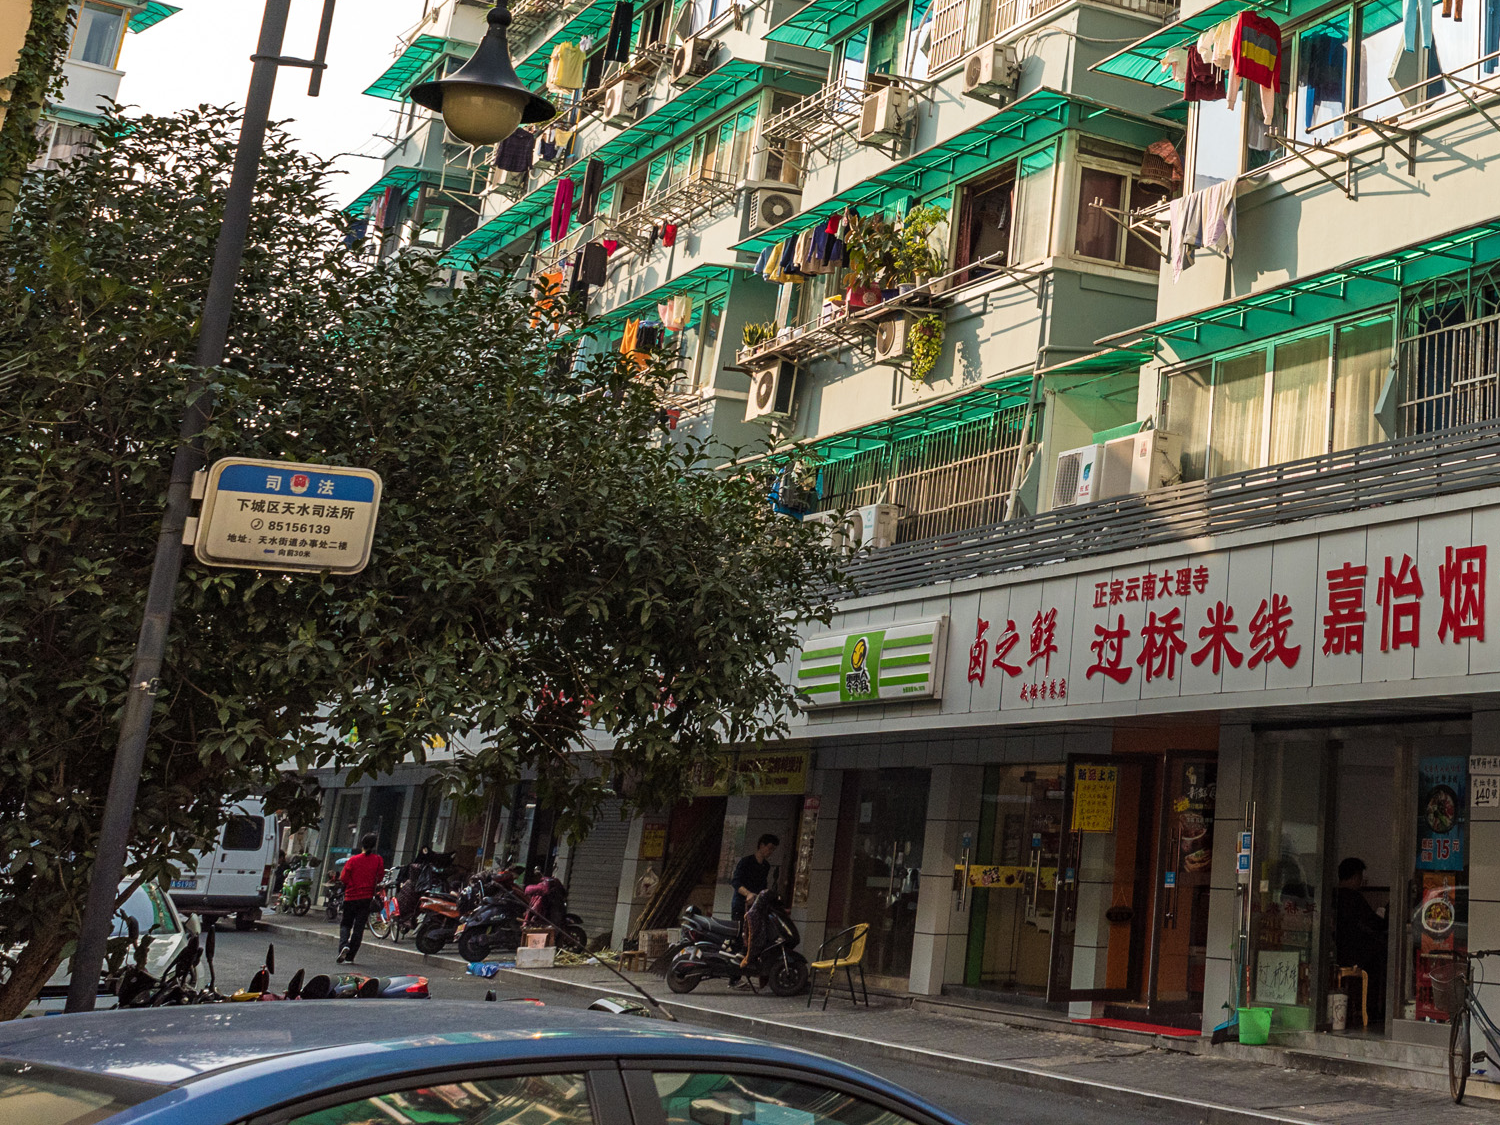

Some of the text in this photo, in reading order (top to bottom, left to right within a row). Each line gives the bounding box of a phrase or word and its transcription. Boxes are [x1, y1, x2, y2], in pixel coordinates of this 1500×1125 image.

[236, 498, 356, 521] 下城区天水司法所
[267, 520, 331, 535] 85156139
[1092, 566, 1209, 609] 正宗云南大理寺
[967, 607, 1059, 687] 卤之鲜
[1086, 593, 1301, 684] 过桥米线
[1436, 839, 1450, 859] 15
